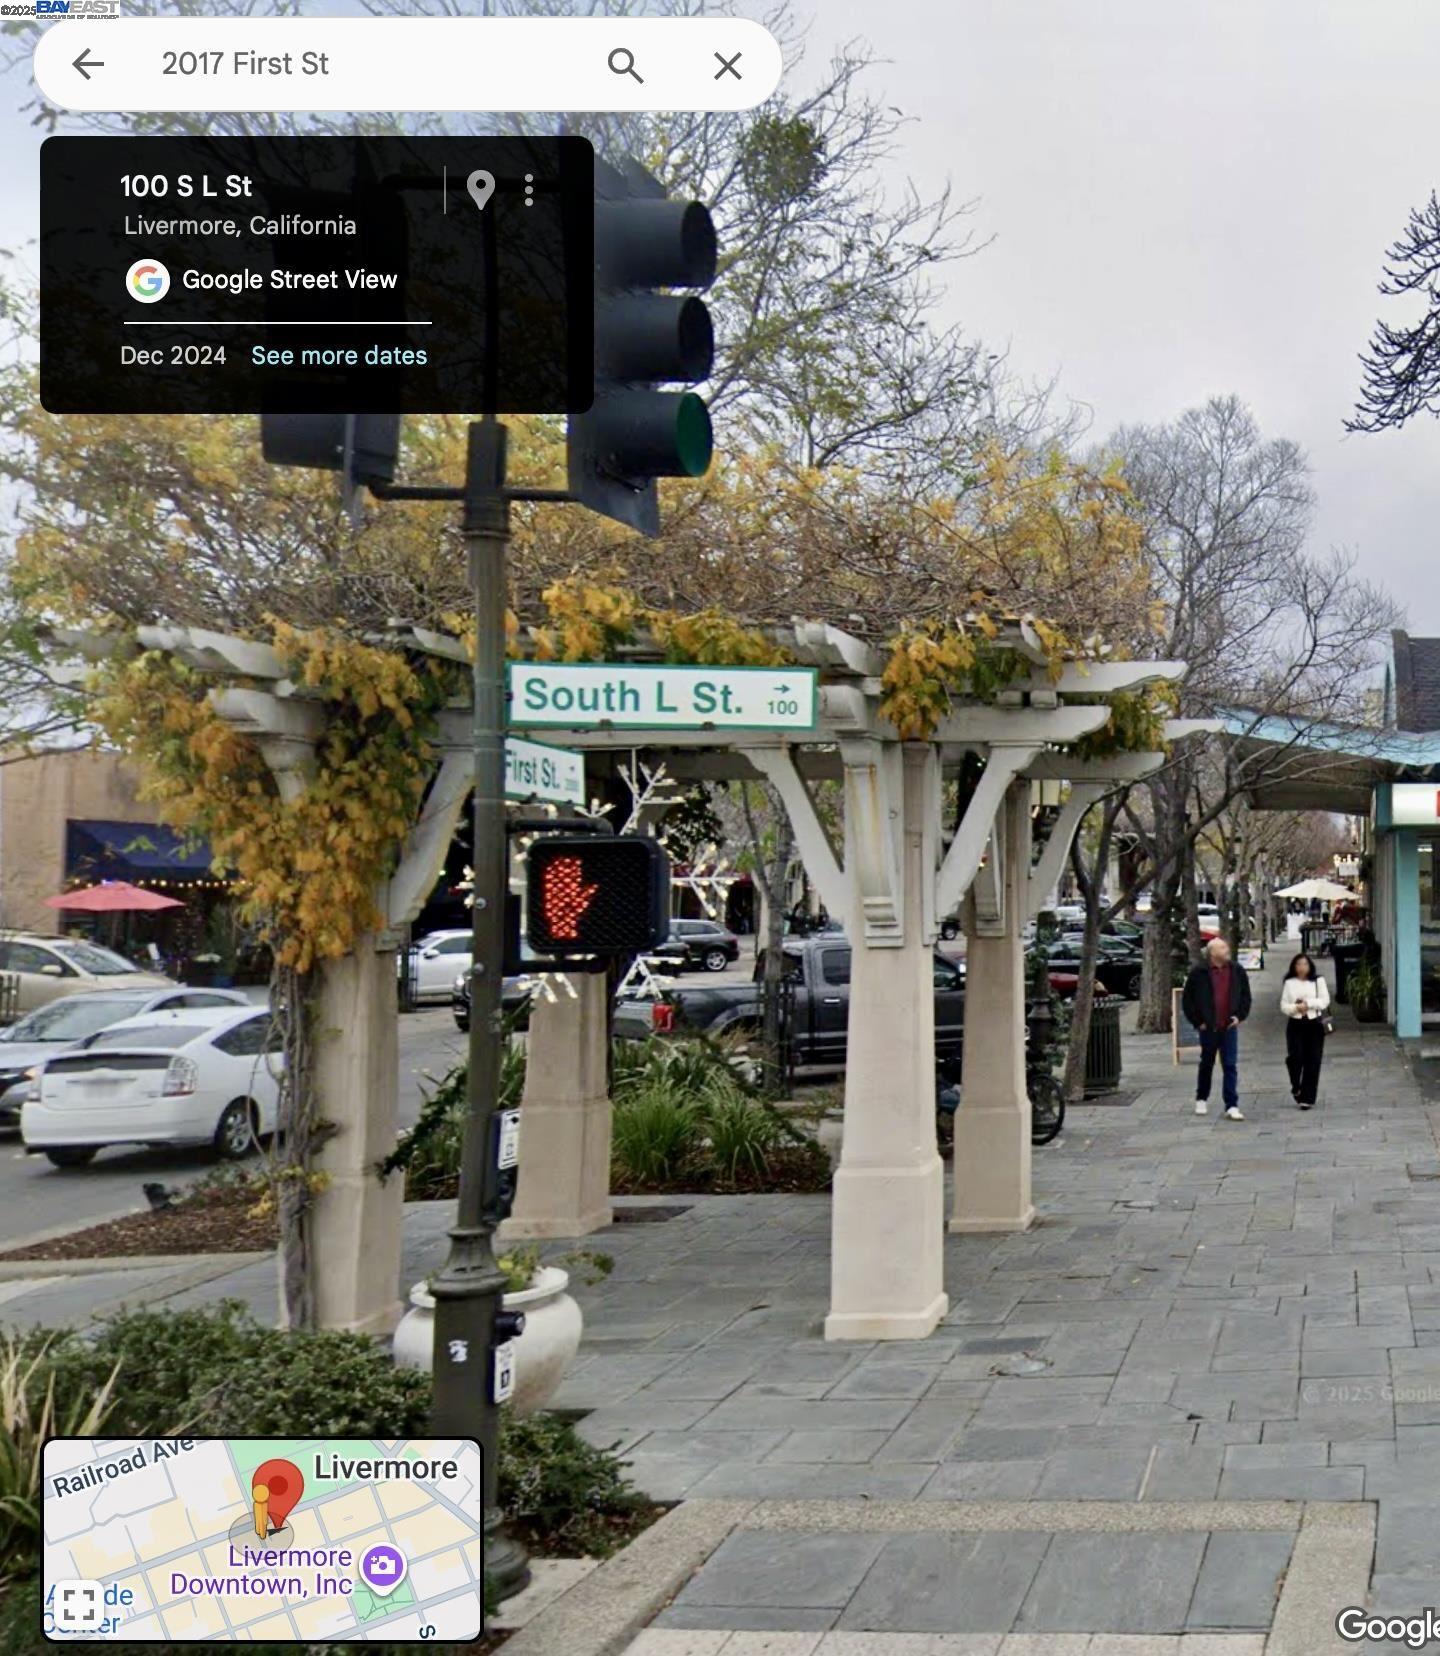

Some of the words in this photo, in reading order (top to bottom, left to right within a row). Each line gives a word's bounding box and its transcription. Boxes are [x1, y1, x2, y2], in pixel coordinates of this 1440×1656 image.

[524, 677, 640, 711] South
[656, 681, 678, 712] L
[693, 681, 743, 714] St.
[767, 700, 798, 715] 100
[541, 757, 560, 789] St.
